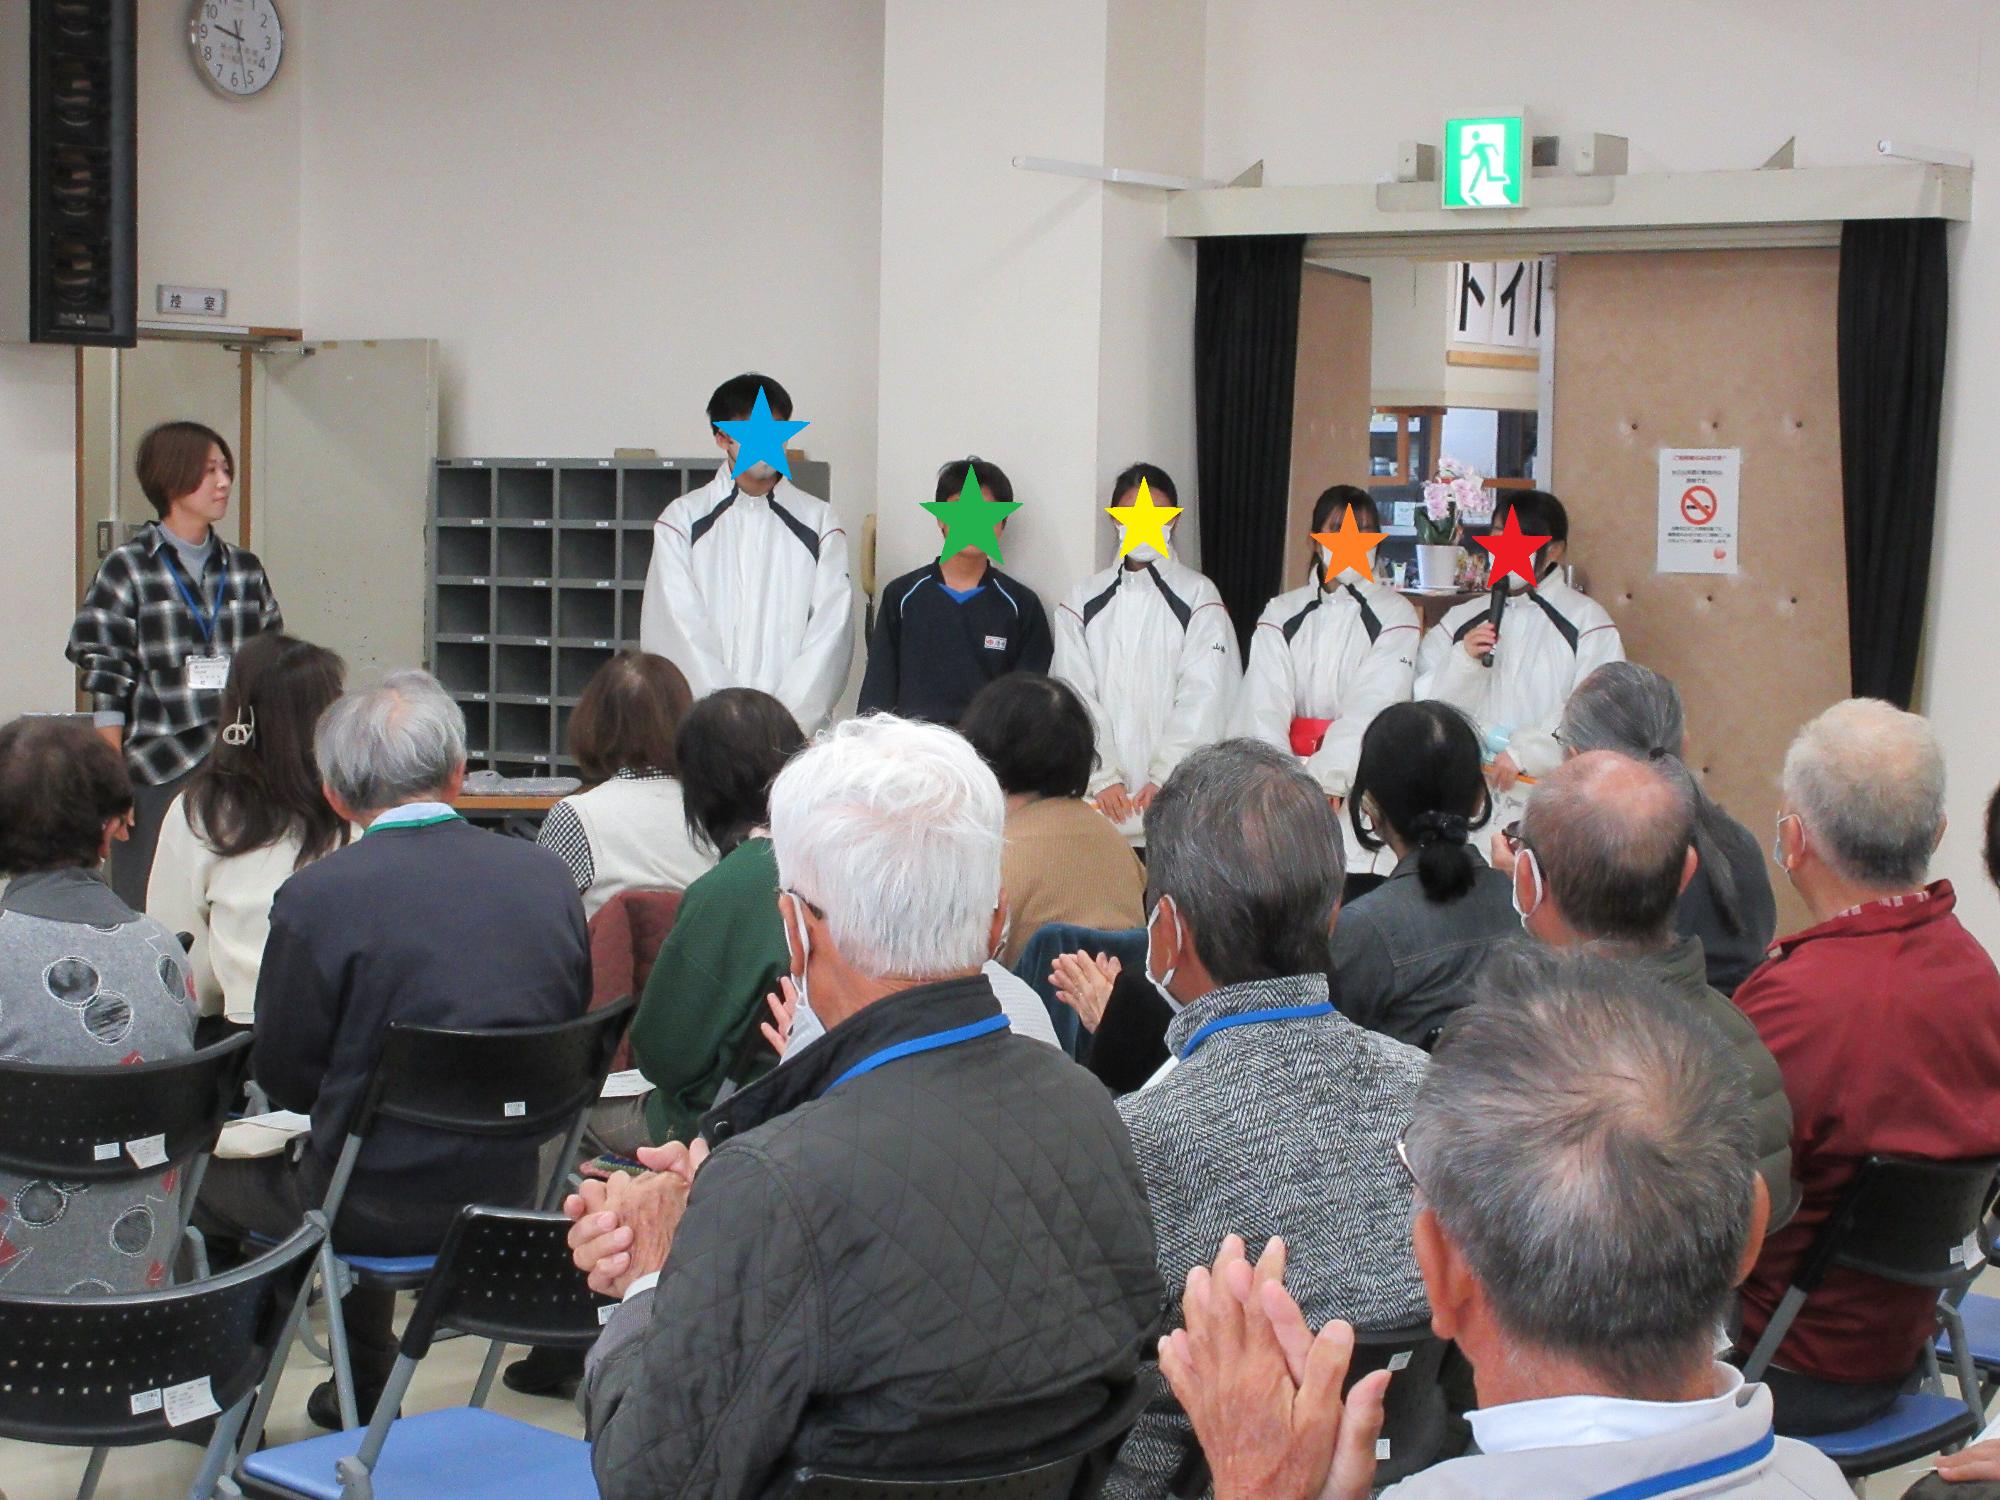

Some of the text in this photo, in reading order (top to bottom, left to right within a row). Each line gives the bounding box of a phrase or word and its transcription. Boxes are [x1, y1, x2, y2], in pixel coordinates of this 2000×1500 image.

[206, 4, 218, 19] 10
[261, 13, 268, 28] 2
[200, 24, 208, 39] 9
[264, 35, 271, 50] 3
[204, 46, 212, 61] 8
[216, 63, 223, 78] 7
[258, 57, 266, 71] 4
[231, 72, 238, 87] 6
[247, 70, 254, 84] 5
